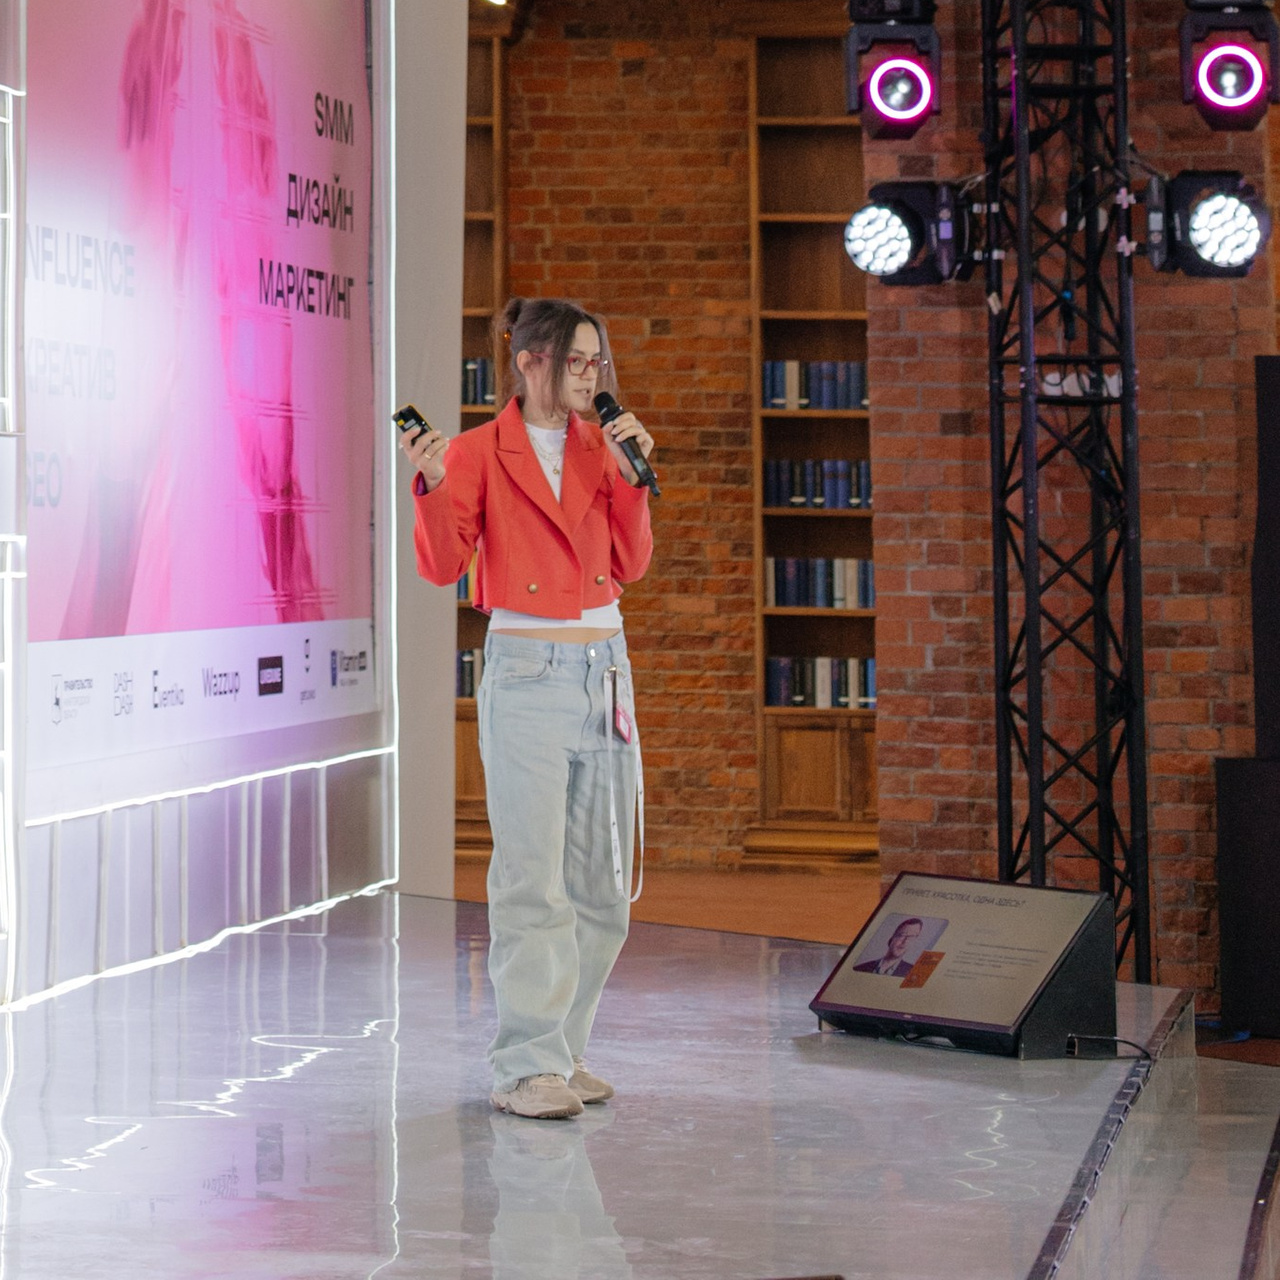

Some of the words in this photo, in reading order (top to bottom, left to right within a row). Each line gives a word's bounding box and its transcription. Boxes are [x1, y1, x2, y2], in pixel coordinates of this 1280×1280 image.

[314, 91, 355, 147] SMM
[287, 172, 355, 234] ДИЗАЙН
[25, 223, 135, 298] NFLUENCE
[258, 257, 355, 320] МАРКЕТИНГ
[202, 667, 241, 702] Wazzup
